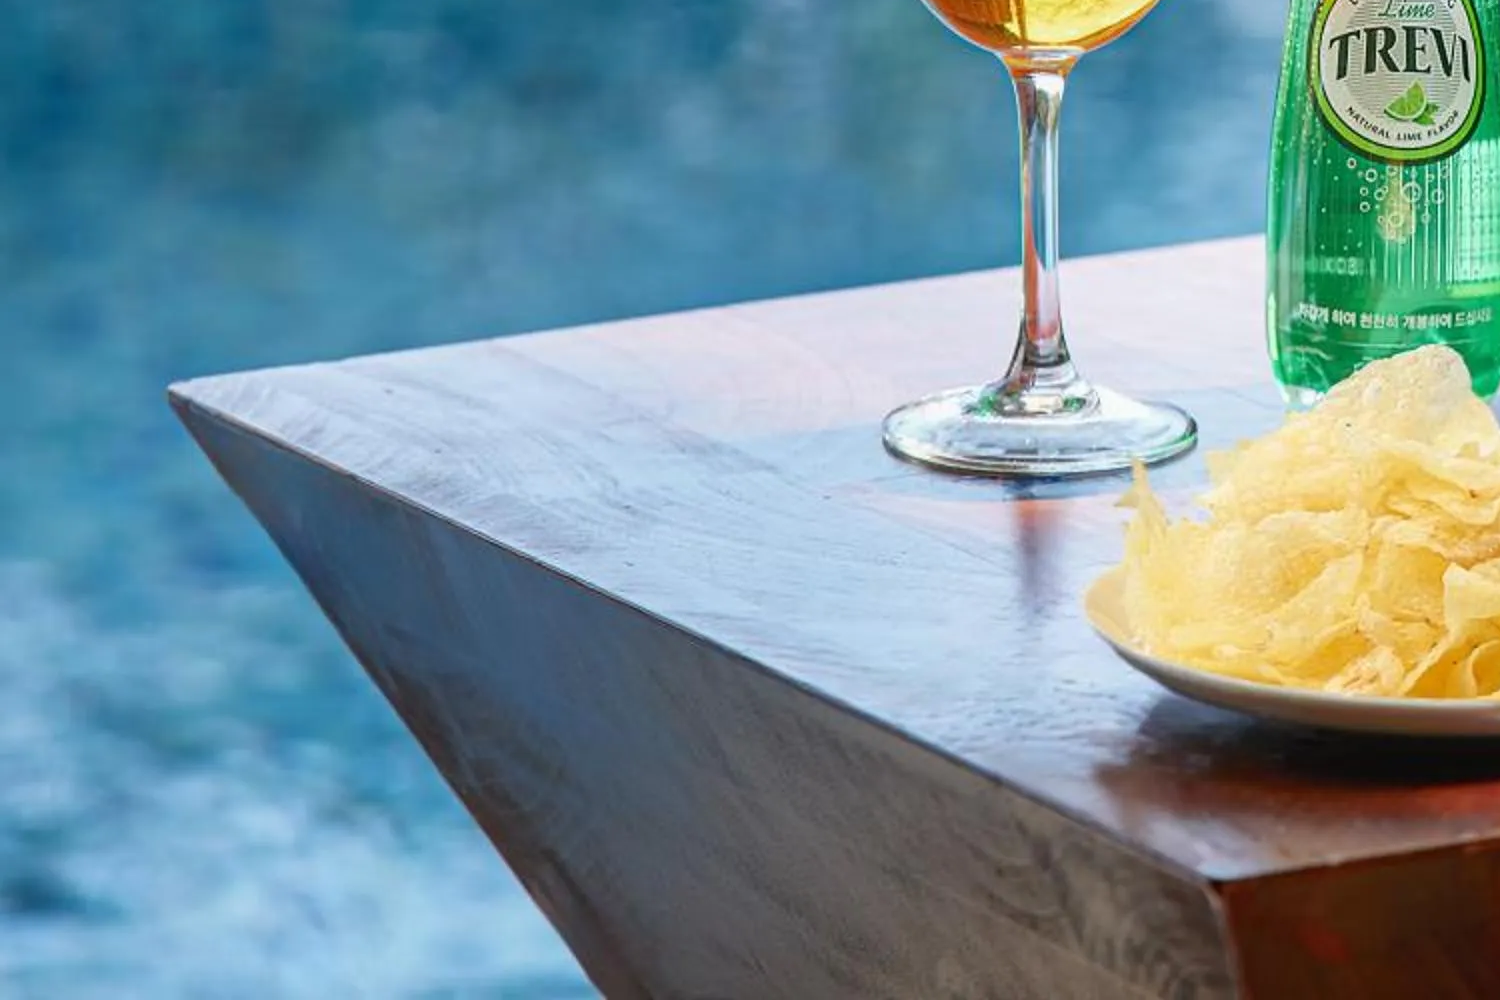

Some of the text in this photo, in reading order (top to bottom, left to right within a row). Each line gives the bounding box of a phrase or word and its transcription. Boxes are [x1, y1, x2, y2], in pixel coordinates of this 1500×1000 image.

[1329, 25, 1471, 82] TREVI
[1346, 106, 1459, 142] NATURAL LIME FLAVOR
[1332, 309, 1357, 328] 하여
